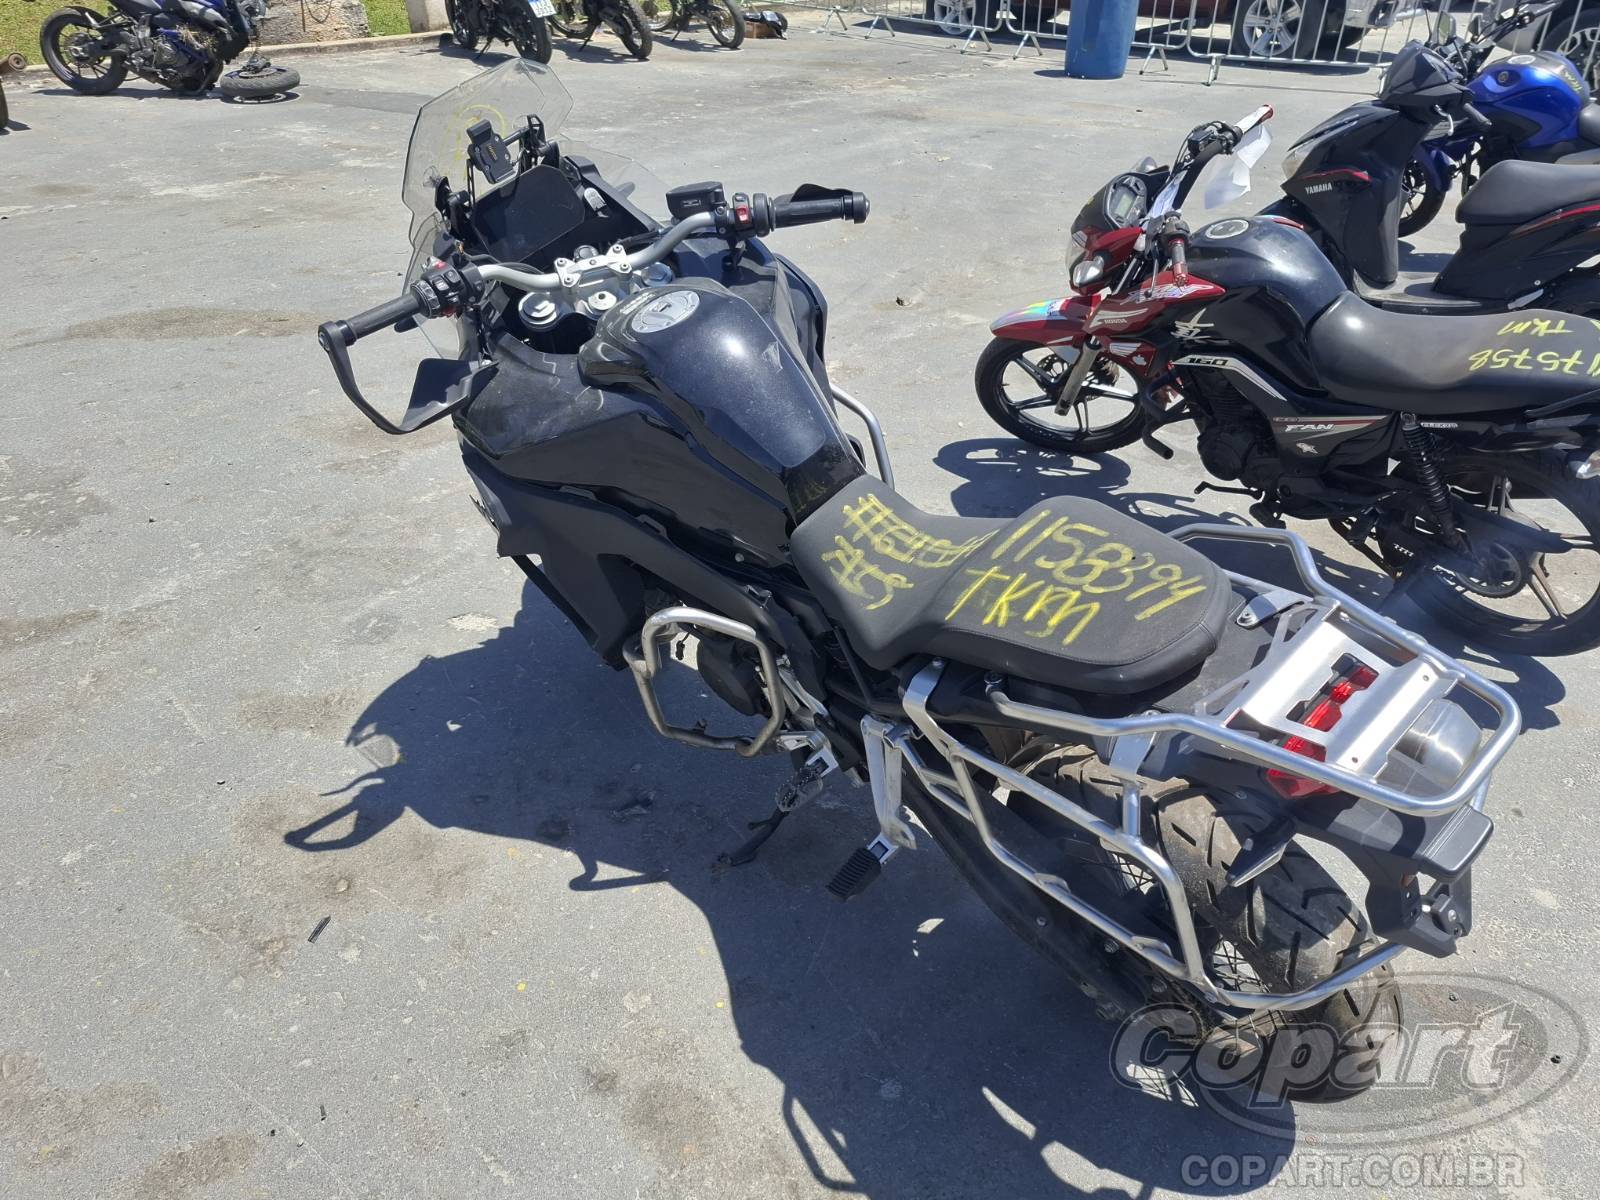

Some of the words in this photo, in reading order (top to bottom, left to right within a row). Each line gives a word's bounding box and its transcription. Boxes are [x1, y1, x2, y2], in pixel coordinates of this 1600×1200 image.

[1305, 182, 1333, 195] YAMAHA
[1188, 357, 1228, 366] 160
[1285, 423, 1335, 433] FAN
